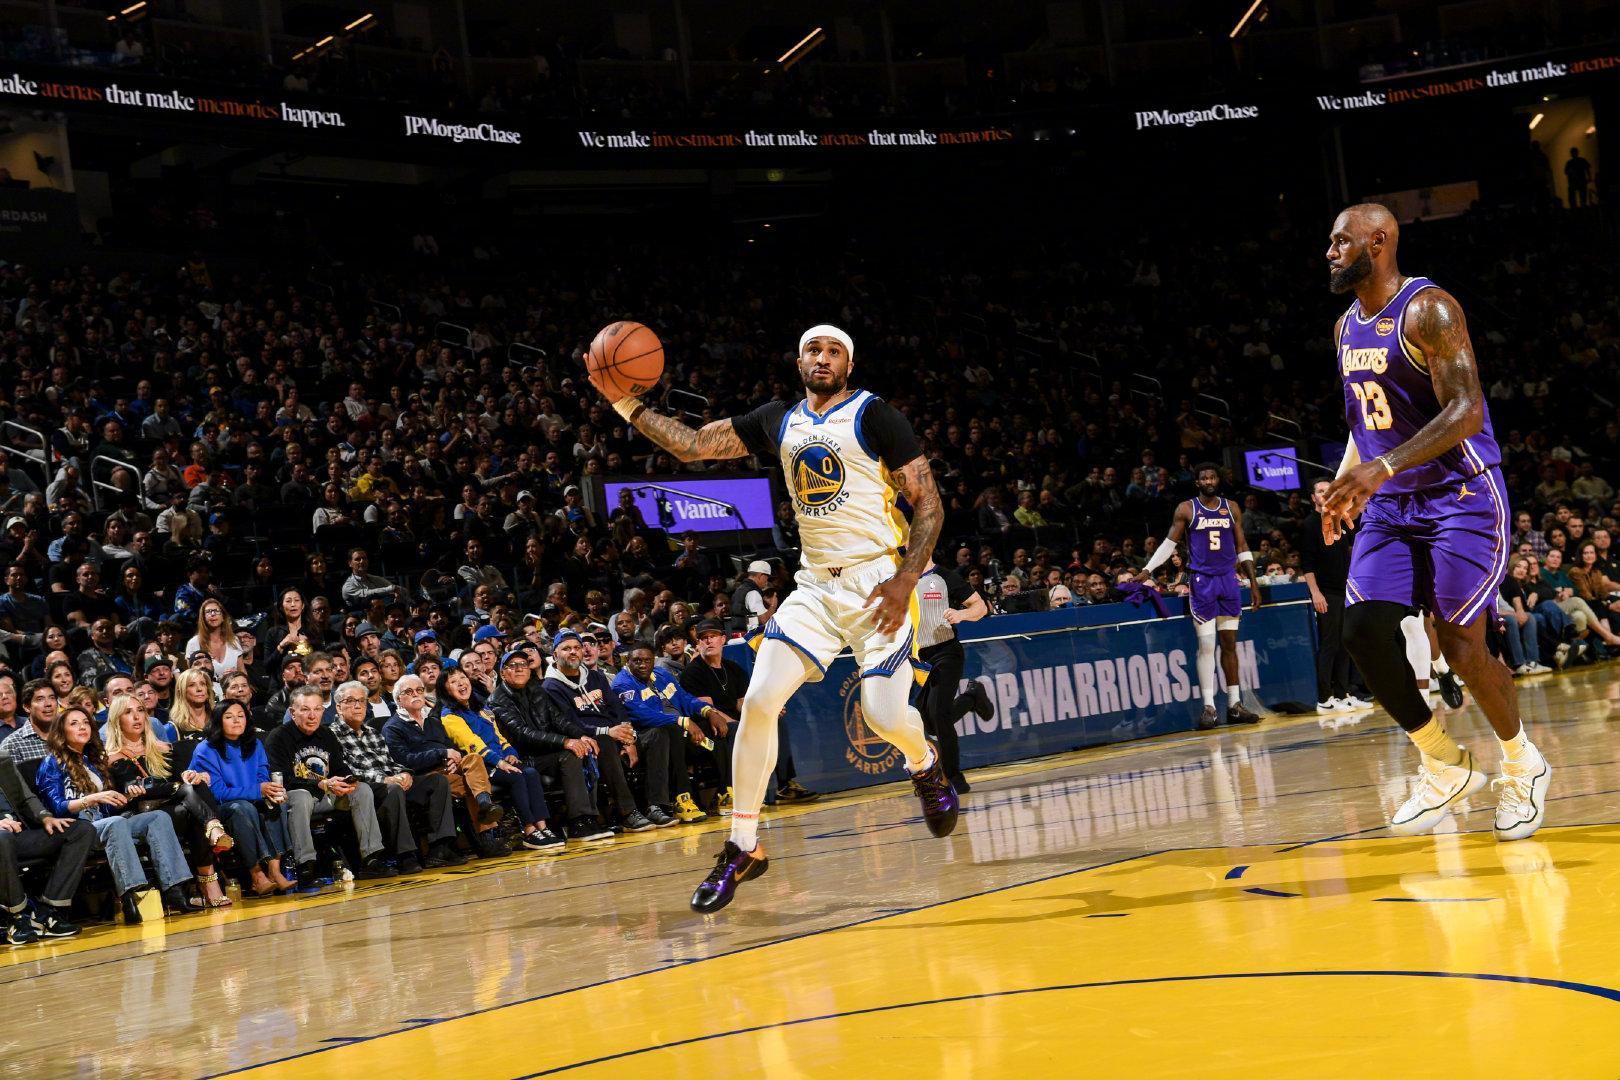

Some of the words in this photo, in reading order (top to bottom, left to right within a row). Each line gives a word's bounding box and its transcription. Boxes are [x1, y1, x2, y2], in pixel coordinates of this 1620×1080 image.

[1317, 94, 1341, 110] We
[1343, 91, 1386, 109] make
[1387, 77, 1483, 103] investments
[1486, 70, 1519, 87] that
[1521, 61, 1567, 81] make
[40, 81, 102, 100] arenas
[105, 84, 143, 106] that
[145, 90, 194, 111] make
[198, 98, 279, 119] memories
[281, 102, 345, 128] happen.
[1135, 104, 1258, 130] JPMorganChase
[405, 115, 521, 144] JPMorganChase
[578, 131, 605, 148] We
[606, 130, 650, 148] make
[652, 131, 742, 147] investments
[744, 130, 775, 146] that
[777, 129, 817, 146] make
[820, 133, 866, 146] arenas
[868, 129, 898, 145] that
[899, 129, 937, 145] make
[939, 126, 1012, 144] memories
[0, 210, 48, 222] RDASH
[1341, 344, 1389, 376] LAKERS
[1349, 380, 1393, 430] 23
[788, 435, 818, 458] GOLDEN
[820, 435, 842, 453] STATE
[822, 456, 833, 475] 0
[1262, 465, 1294, 478] Vanta
[1195, 516, 1231, 530] LAKERS
[1209, 530, 1221, 551] 5
[846, 746, 901, 775] WARRIOR
